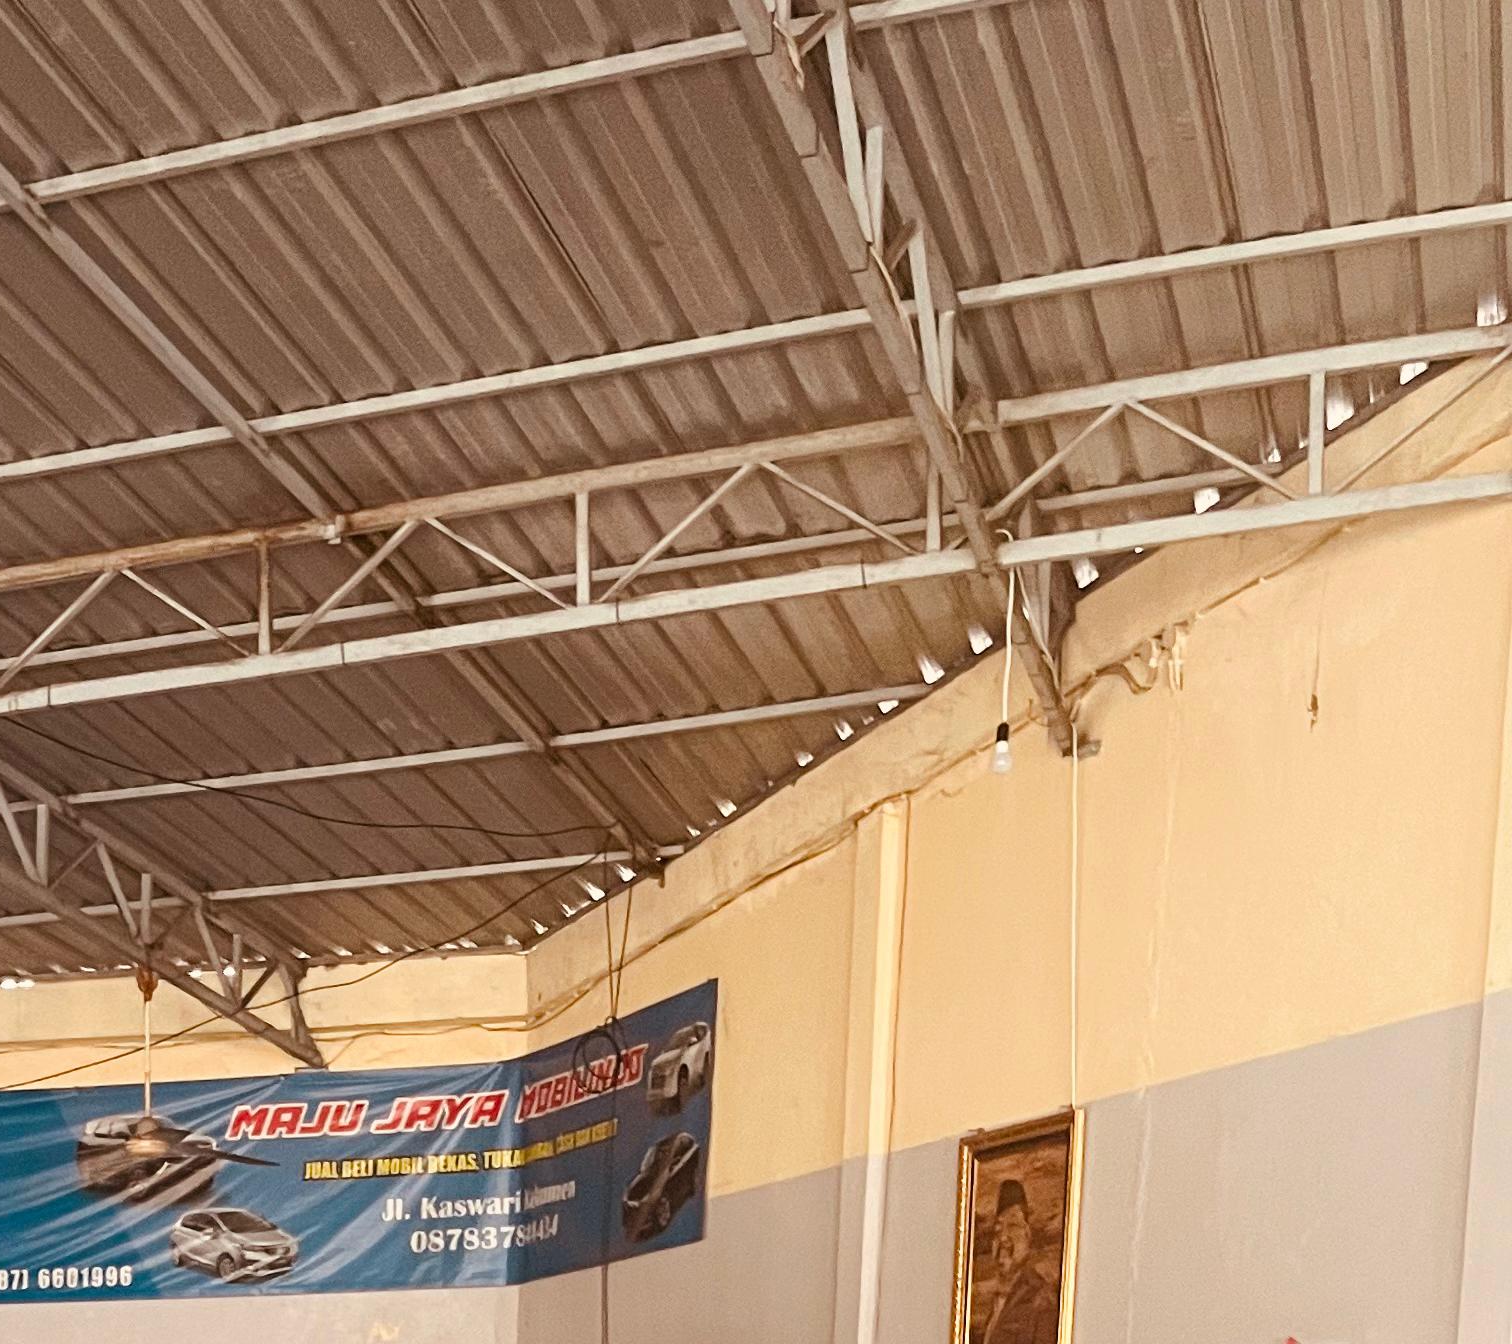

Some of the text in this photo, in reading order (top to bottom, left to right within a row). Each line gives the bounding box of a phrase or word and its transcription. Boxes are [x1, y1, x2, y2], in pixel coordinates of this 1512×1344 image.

[226, 1101, 368, 1140] MAJU
[371, 1090, 509, 1131] JAYA
[304, 1161, 338, 1180] JUAL
[341, 1159, 374, 1178] BELI
[376, 1156, 424, 1176] MOBIL
[382, 1198, 411, 1222] Jl.
[420, 1191, 522, 1220] Kaswari
[37, 1265, 133, 1289] 6601996
